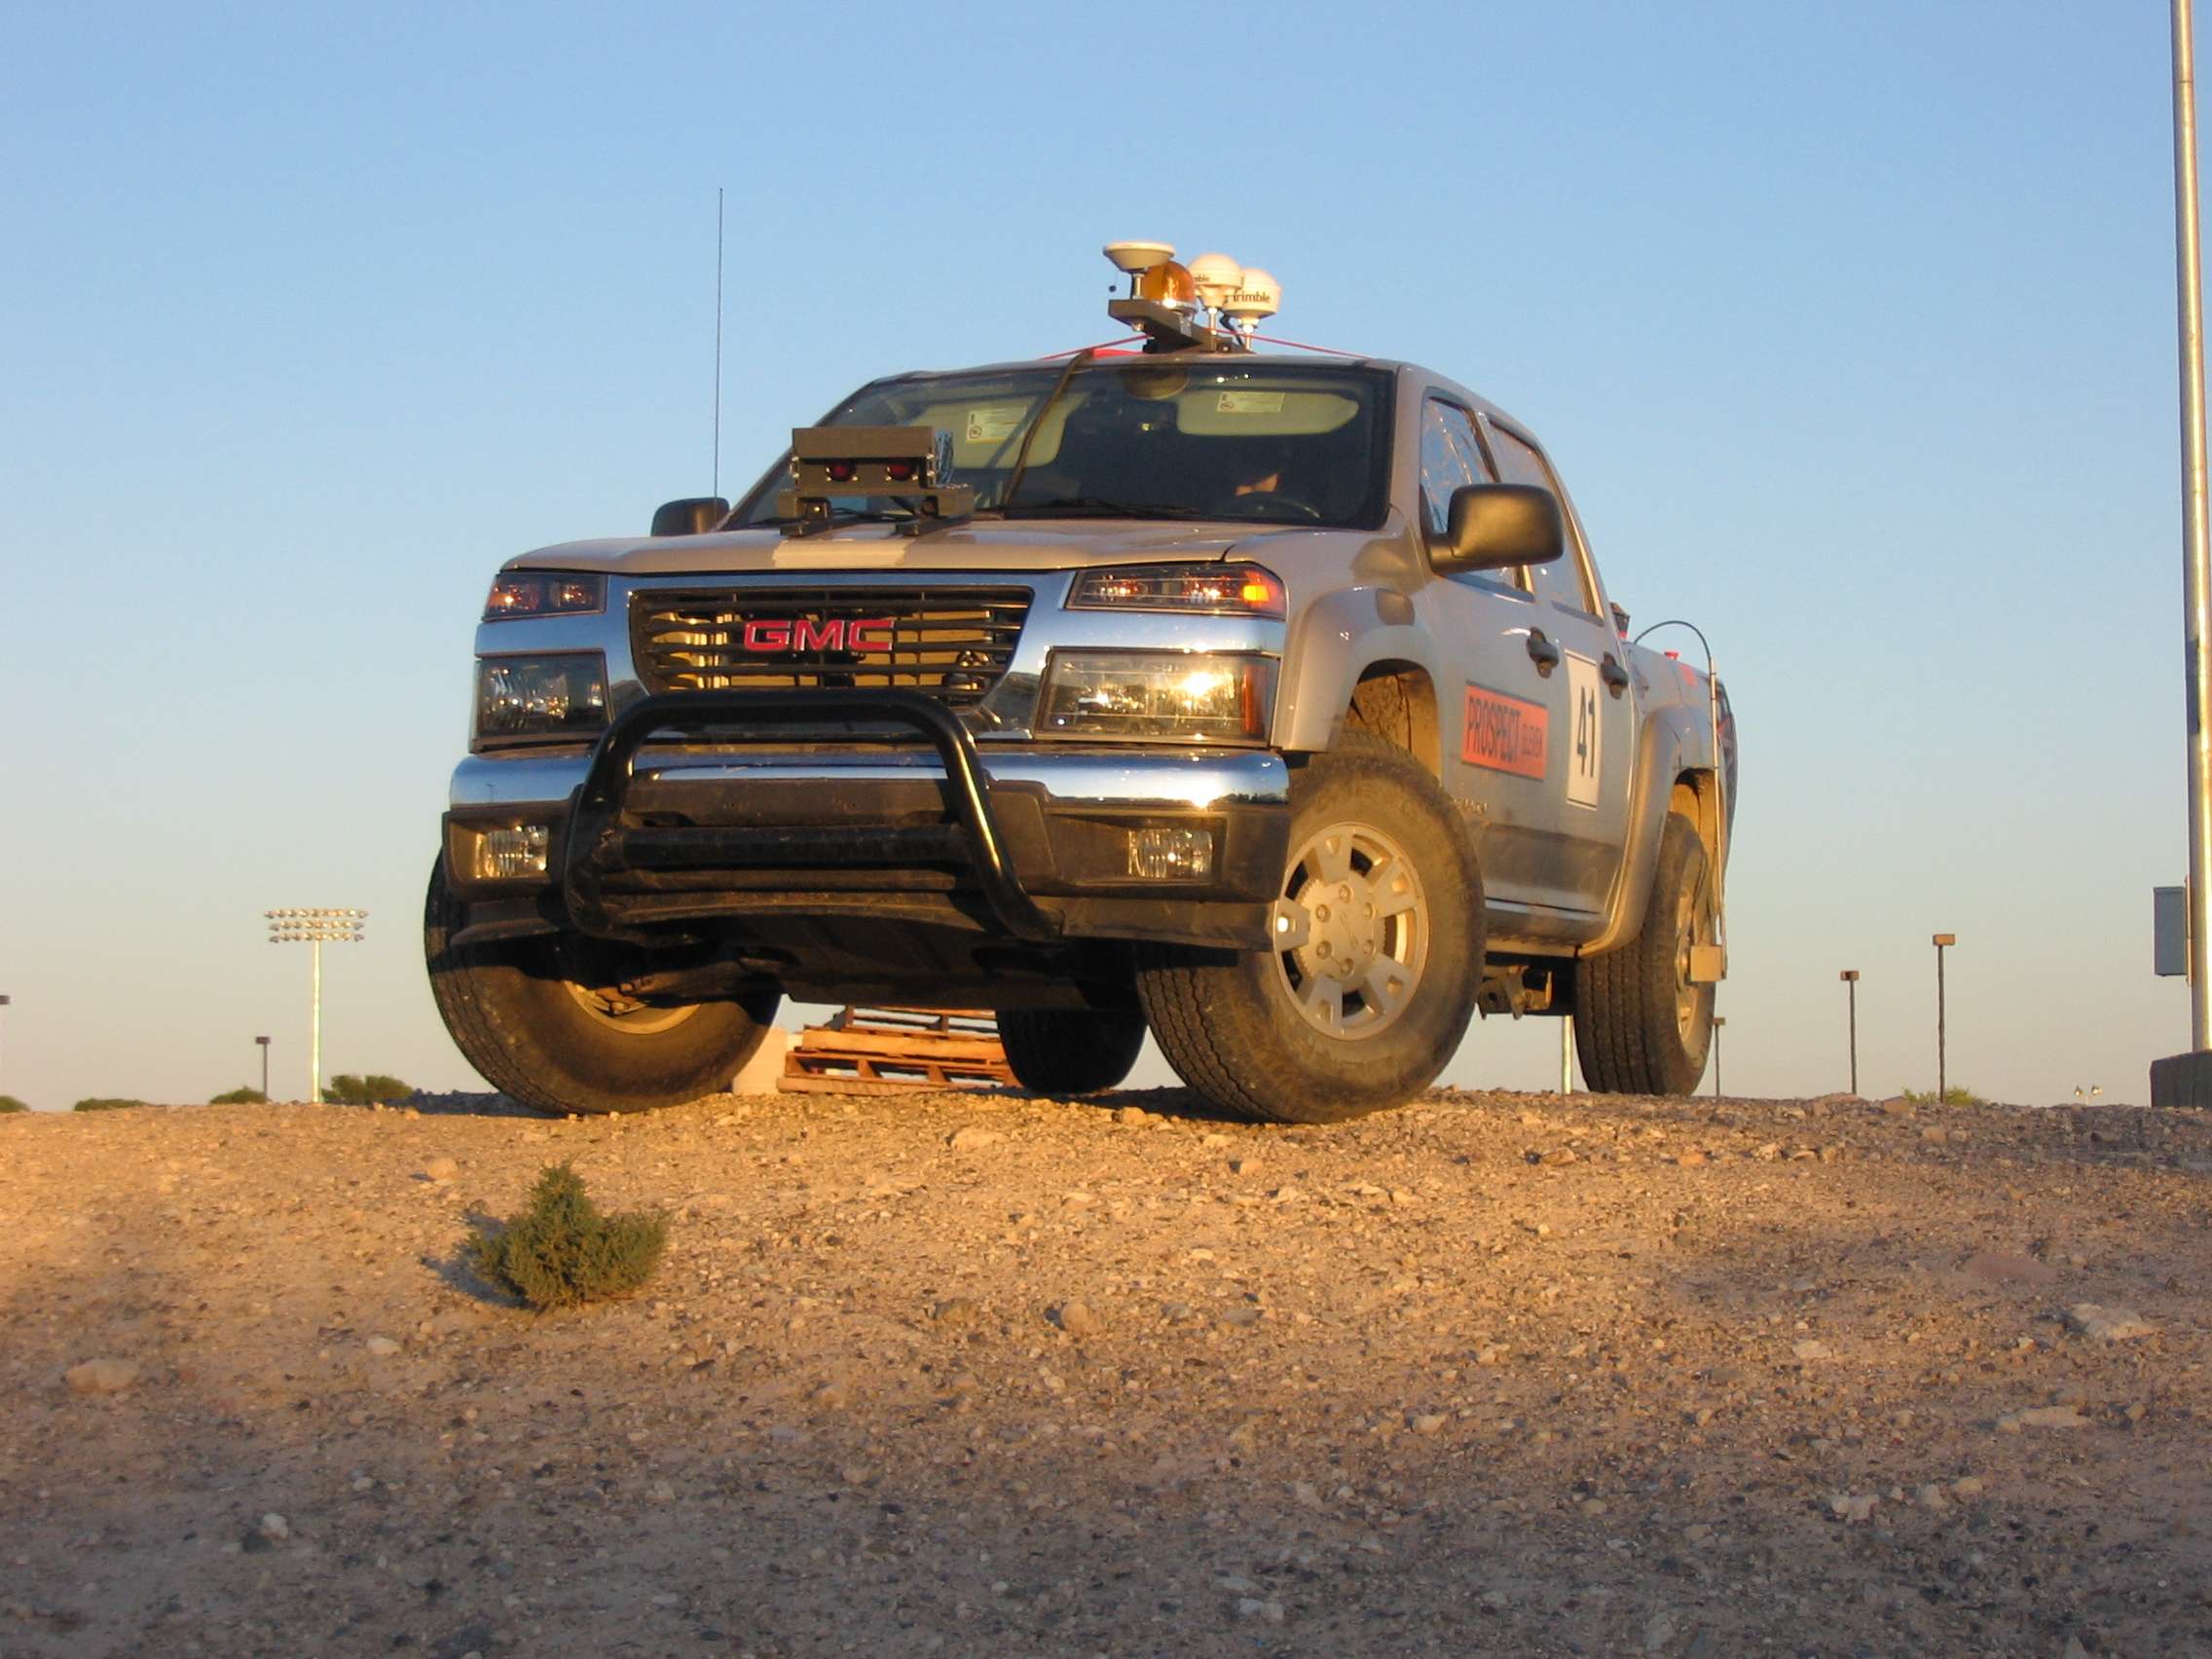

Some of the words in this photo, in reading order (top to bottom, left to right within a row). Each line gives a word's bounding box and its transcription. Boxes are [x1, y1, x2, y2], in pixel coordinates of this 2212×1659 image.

[744, 620, 895, 651] GMC
[1466, 695, 1521, 763] PROSPECT
[1577, 686, 1596, 778] 41
